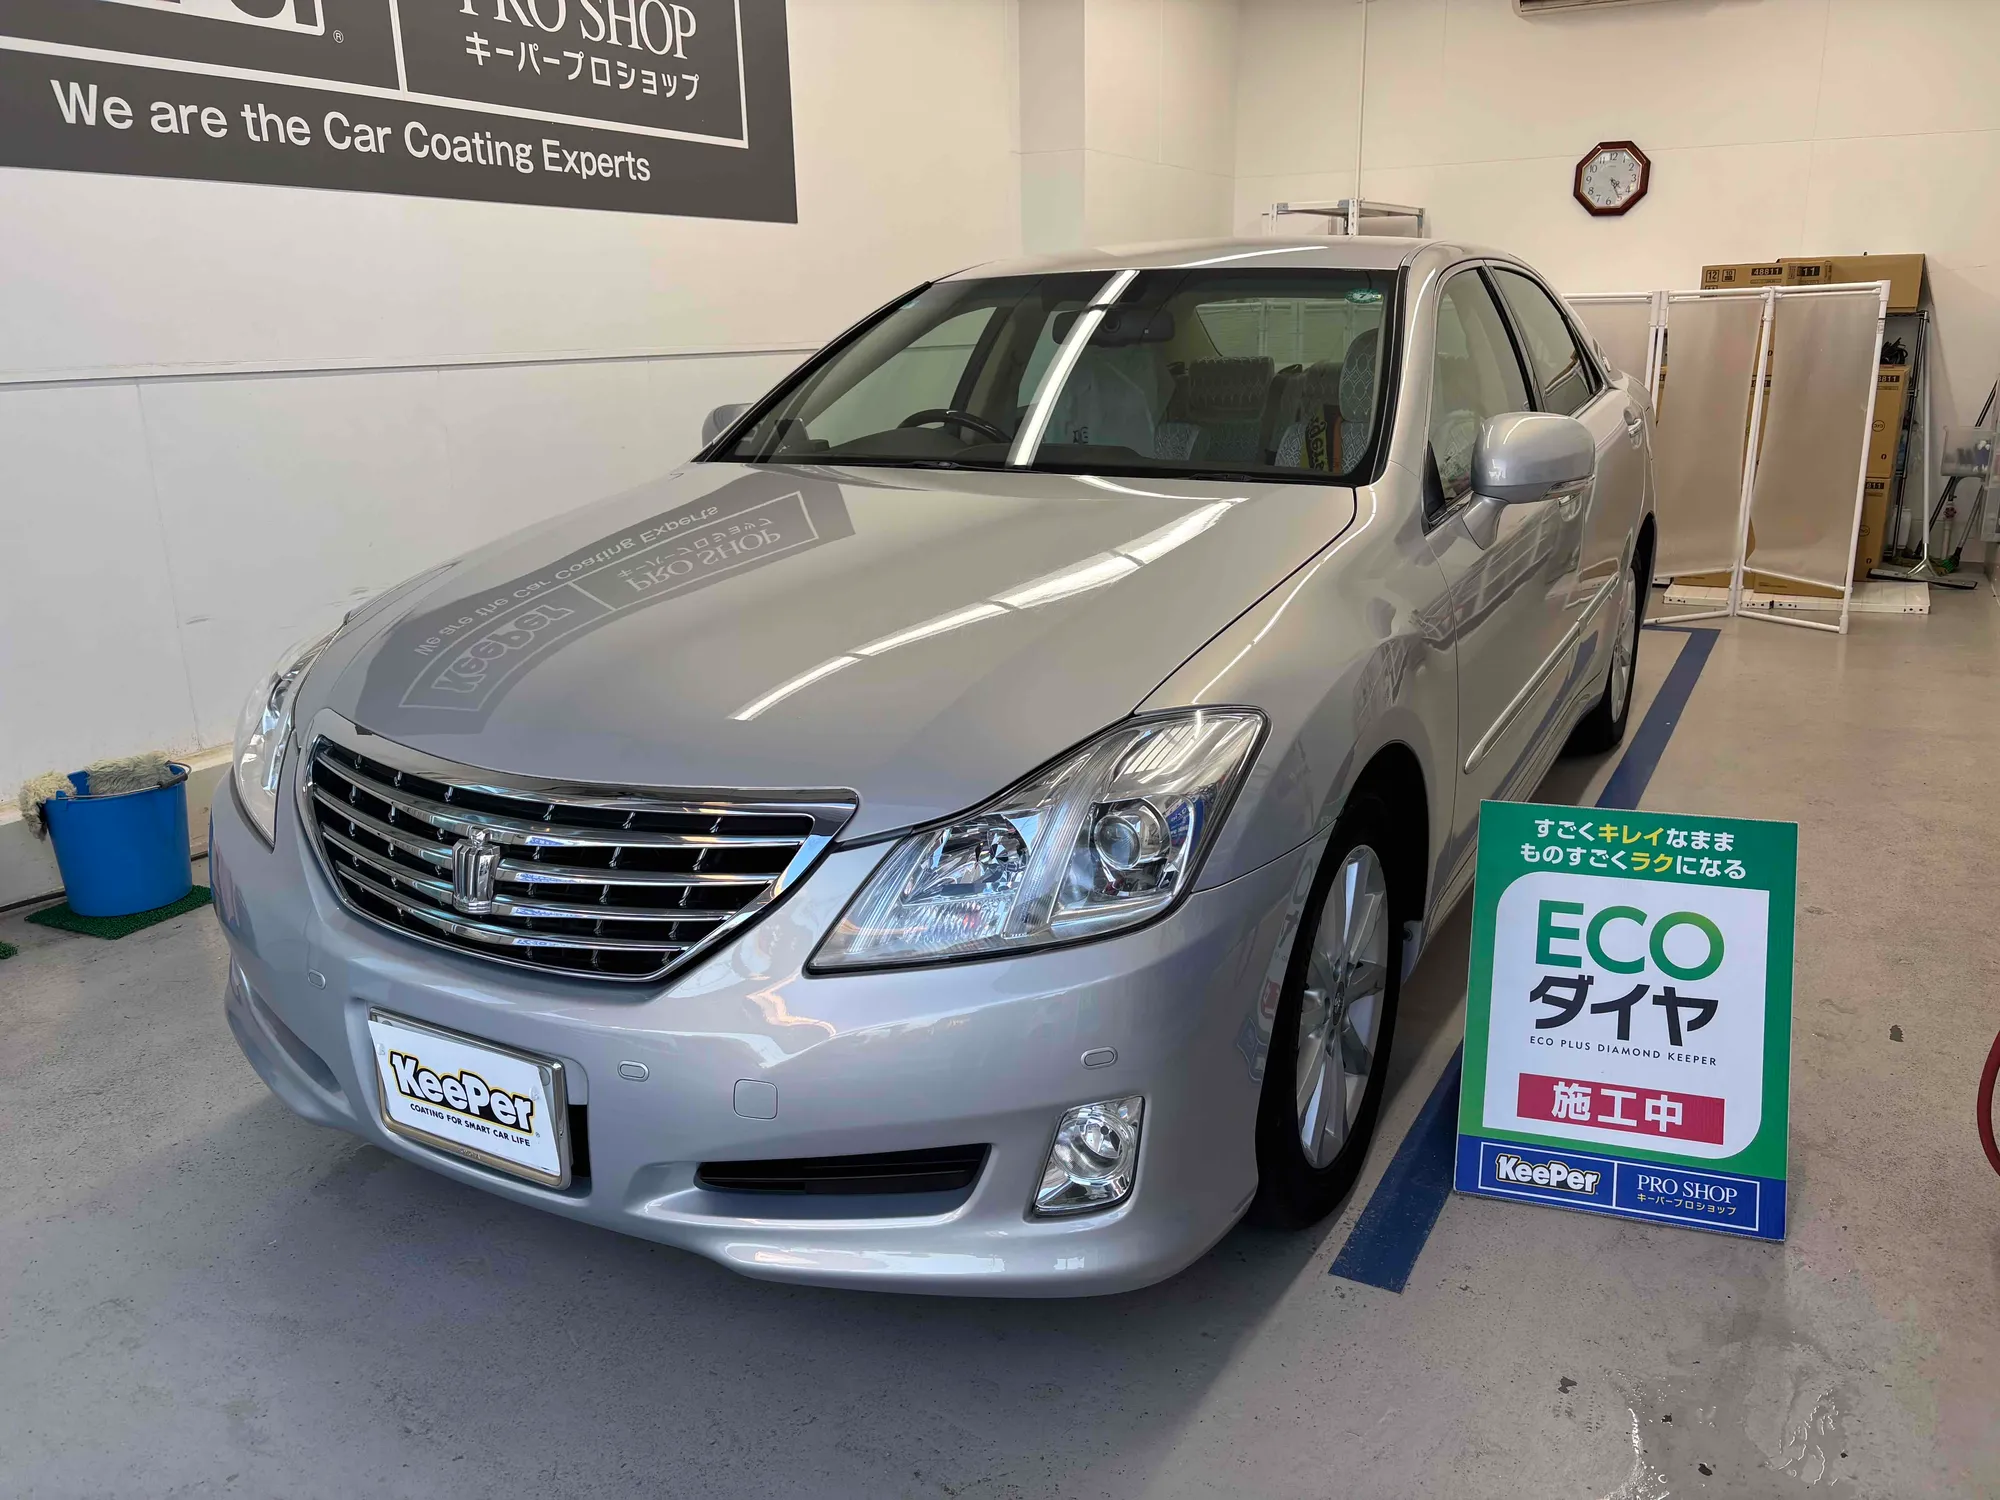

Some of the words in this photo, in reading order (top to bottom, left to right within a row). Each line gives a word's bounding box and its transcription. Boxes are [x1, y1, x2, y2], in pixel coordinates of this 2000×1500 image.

[580, 0, 697, 59] SHOP
[465, 31, 700, 100] キーパープロショップ
[50, 79, 133, 129] We
[150, 101, 227, 138] are
[241, 103, 311, 146] the
[323, 111, 392, 153] Car
[404, 121, 534, 174] Coating
[542, 139, 650, 181] Experts
[1521, 843, 1746, 879] ものすごくラクになる
[1534, 818, 1735, 852] すごくキレイなまま
[1535, 899, 1725, 981] ECO
[1530, 974, 1719, 1046] ダイヤ
[1530, 1036, 1554, 1046] ECO
[1561, 1039, 1591, 1050] PLUS
[1598, 1044, 1660, 1059] DIAMOND
[1667, 1052, 1717, 1066] KEEPER
[389, 1050, 534, 1134] KeePer
[1551, 1081, 1683, 1133] 施工中
[410, 1103, 444, 1120] COATING
[446, 1114, 463, 1126] FOR
[465, 1120, 491, 1135] SMART
[493, 1129, 510, 1140] CAR
[511, 1135, 531, 1147] LIFE
[1496, 1154, 1601, 1195] KeePer
[1637, 1174, 1678, 1195] PRO
[1683, 1181, 1738, 1204] SHOP
